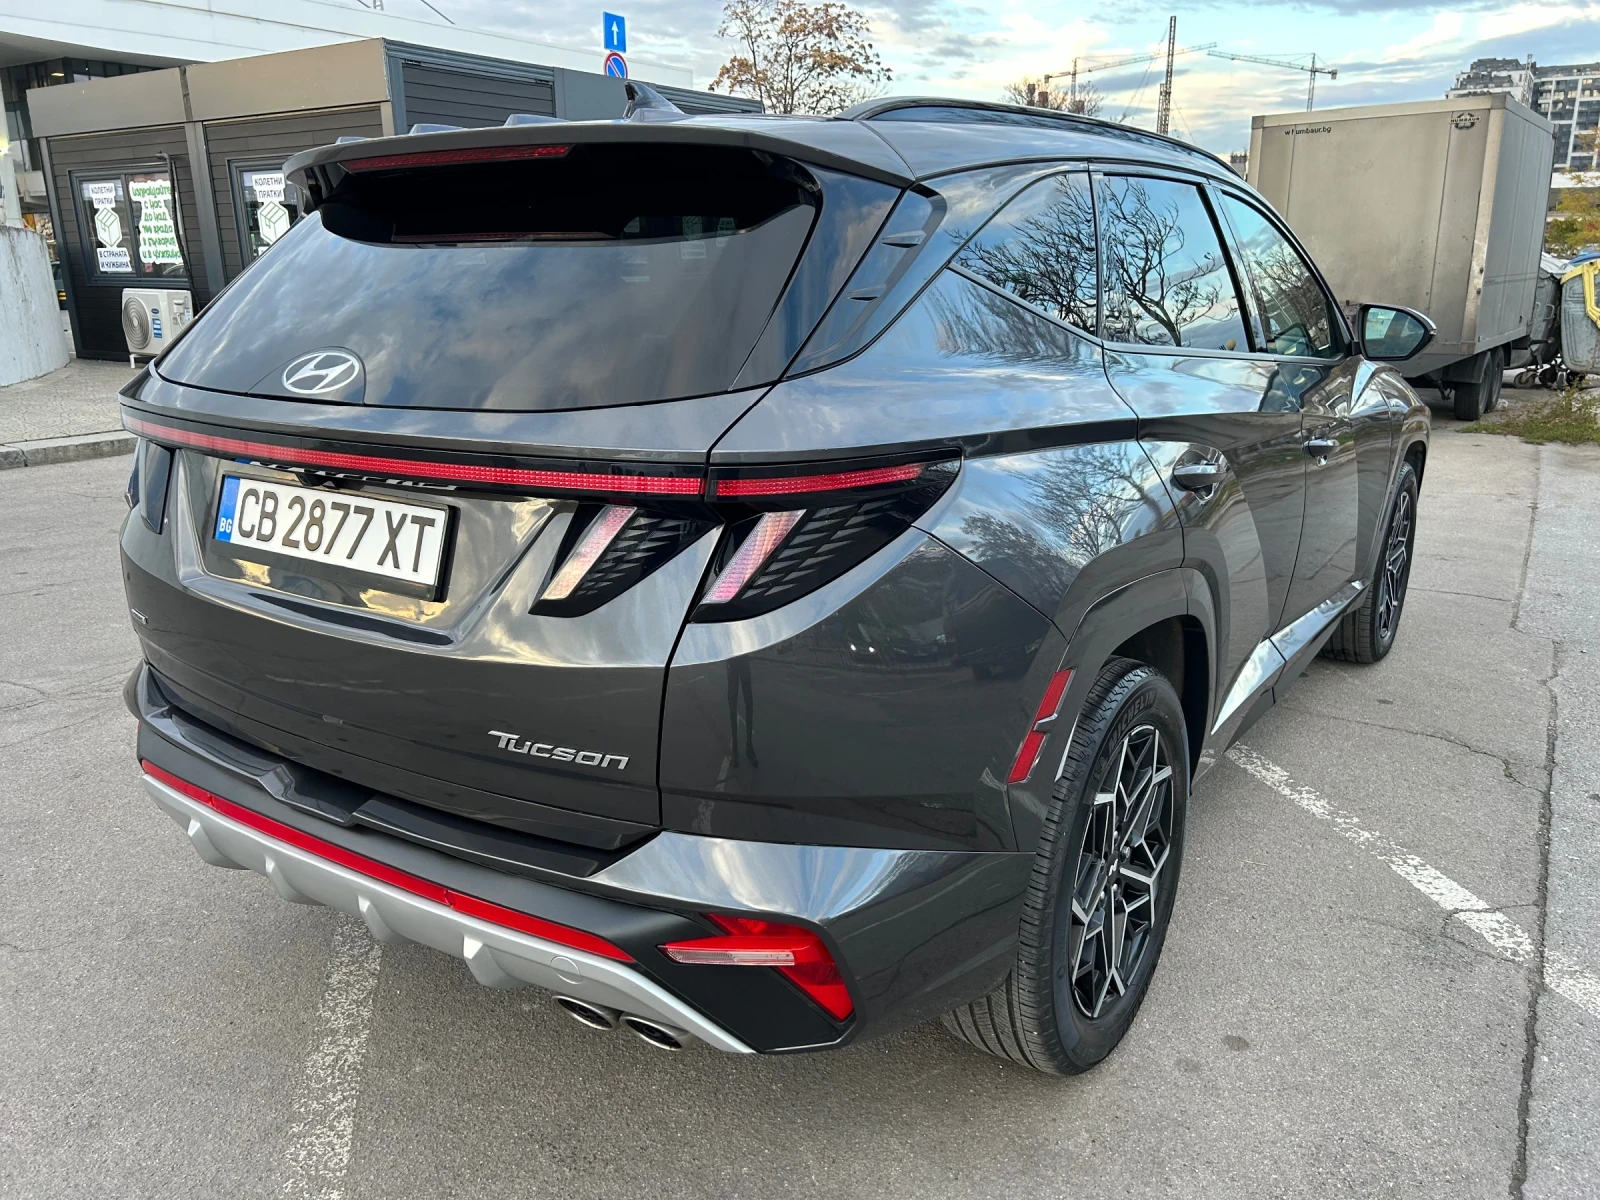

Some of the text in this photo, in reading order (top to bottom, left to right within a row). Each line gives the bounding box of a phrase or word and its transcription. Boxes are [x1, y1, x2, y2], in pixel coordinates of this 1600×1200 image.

[254, 177, 283, 187] КОЛЕТНИ
[91, 186, 114, 194] КОЛЕТНИ
[258, 189, 282, 199] ПРАТКИ
[94, 197, 113, 206] ПРАТКИ
[103, 249, 127, 259] СТРАНАТА
[105, 260, 130, 269] ЧУЖБИНА
[219, 517, 232, 533] BG
[281, 495, 375, 560] 2877
